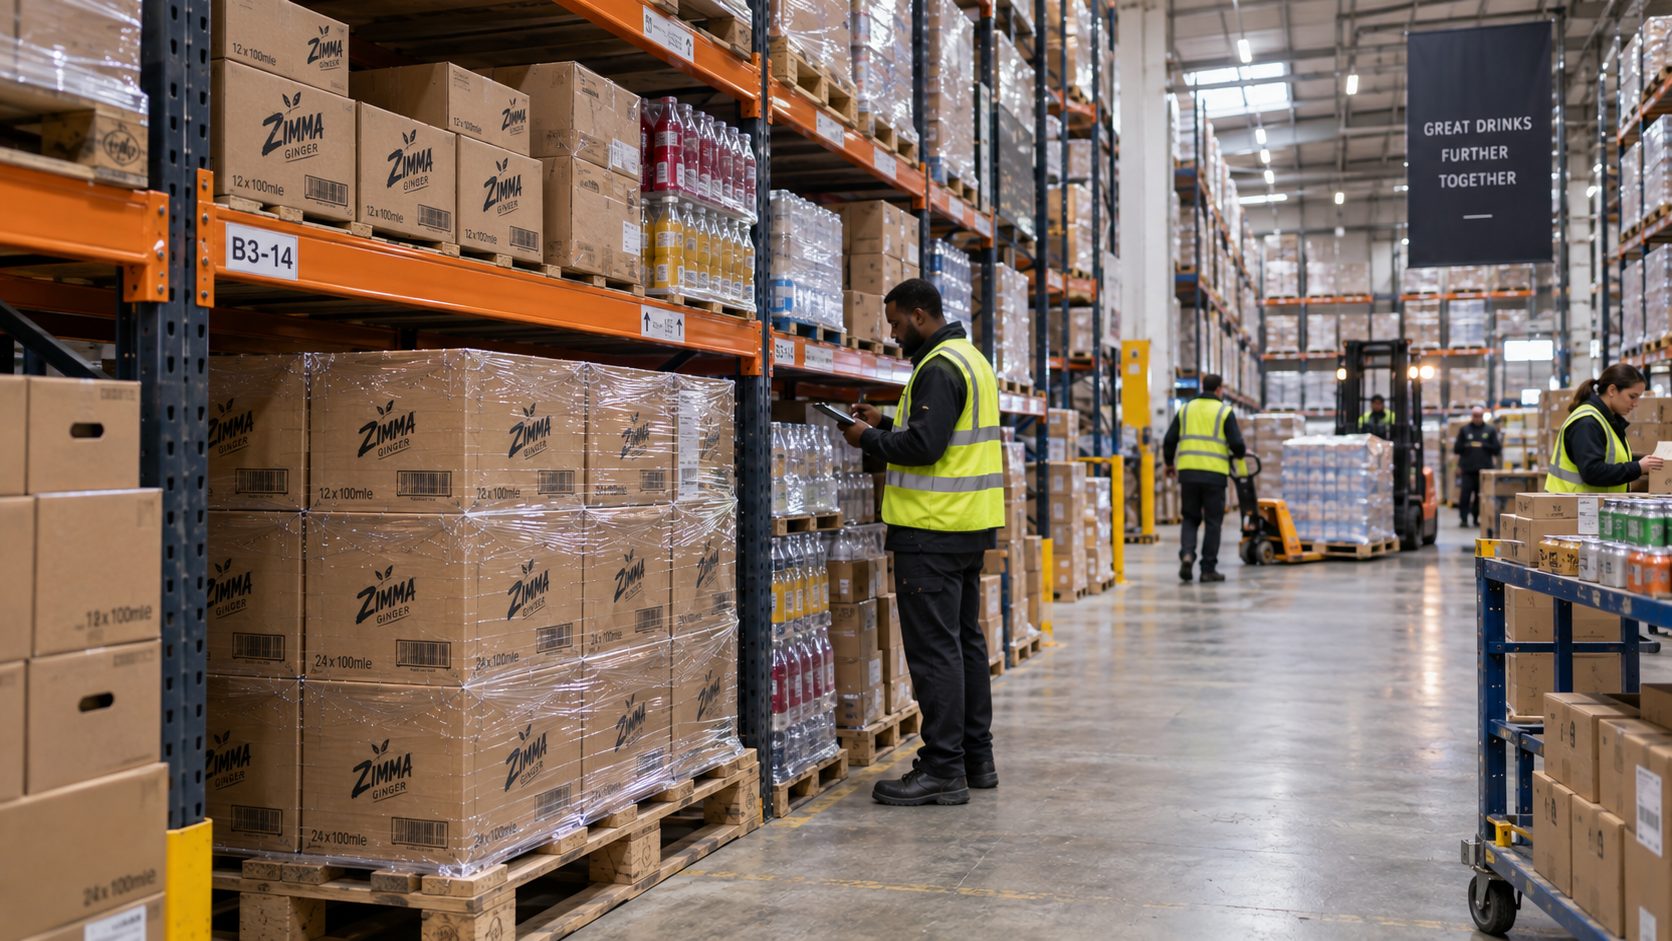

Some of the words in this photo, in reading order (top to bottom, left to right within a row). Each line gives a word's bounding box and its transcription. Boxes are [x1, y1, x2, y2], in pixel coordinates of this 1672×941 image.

[232, 42, 242, 55] 12
[307, 37, 343, 65] ZIMMA
[261, 112, 324, 157] ZIMMA
[1423, 120, 1471, 136] GREAT
[1475, 116, 1533, 133] DRINKS
[284, 143, 319, 160] GINGER
[1441, 145, 1509, 162] FURTHER
[386, 147, 433, 189] ZIMMA
[1438, 171, 1517, 188] TOGETHER
[232, 175, 243, 188] 12
[252, 179, 284, 196] 100mle
[483, 174, 522, 213] ZIMMA
[232, 236, 293, 270] B3-14
[357, 411, 416, 458] ZIMMA
[508, 415, 552, 459] ZIMMA
[319, 487, 330, 499] 12
[332, 490, 338, 499] x
[340, 487, 373, 500] 100mle
[356, 577, 417, 624] ZIMMA
[507, 570, 550, 621] ZIMMA
[376, 606, 410, 624] GINGER
[315, 655, 328, 668] 24
[329, 658, 335, 668] x
[337, 656, 372, 669] 100mle
[505, 732, 548, 792] ZIMMA
[351, 752, 413, 799] ZIMMA
[372, 781, 406, 800] GINGER
[311, 829, 323, 843] 24
[324, 833, 331, 843] x
